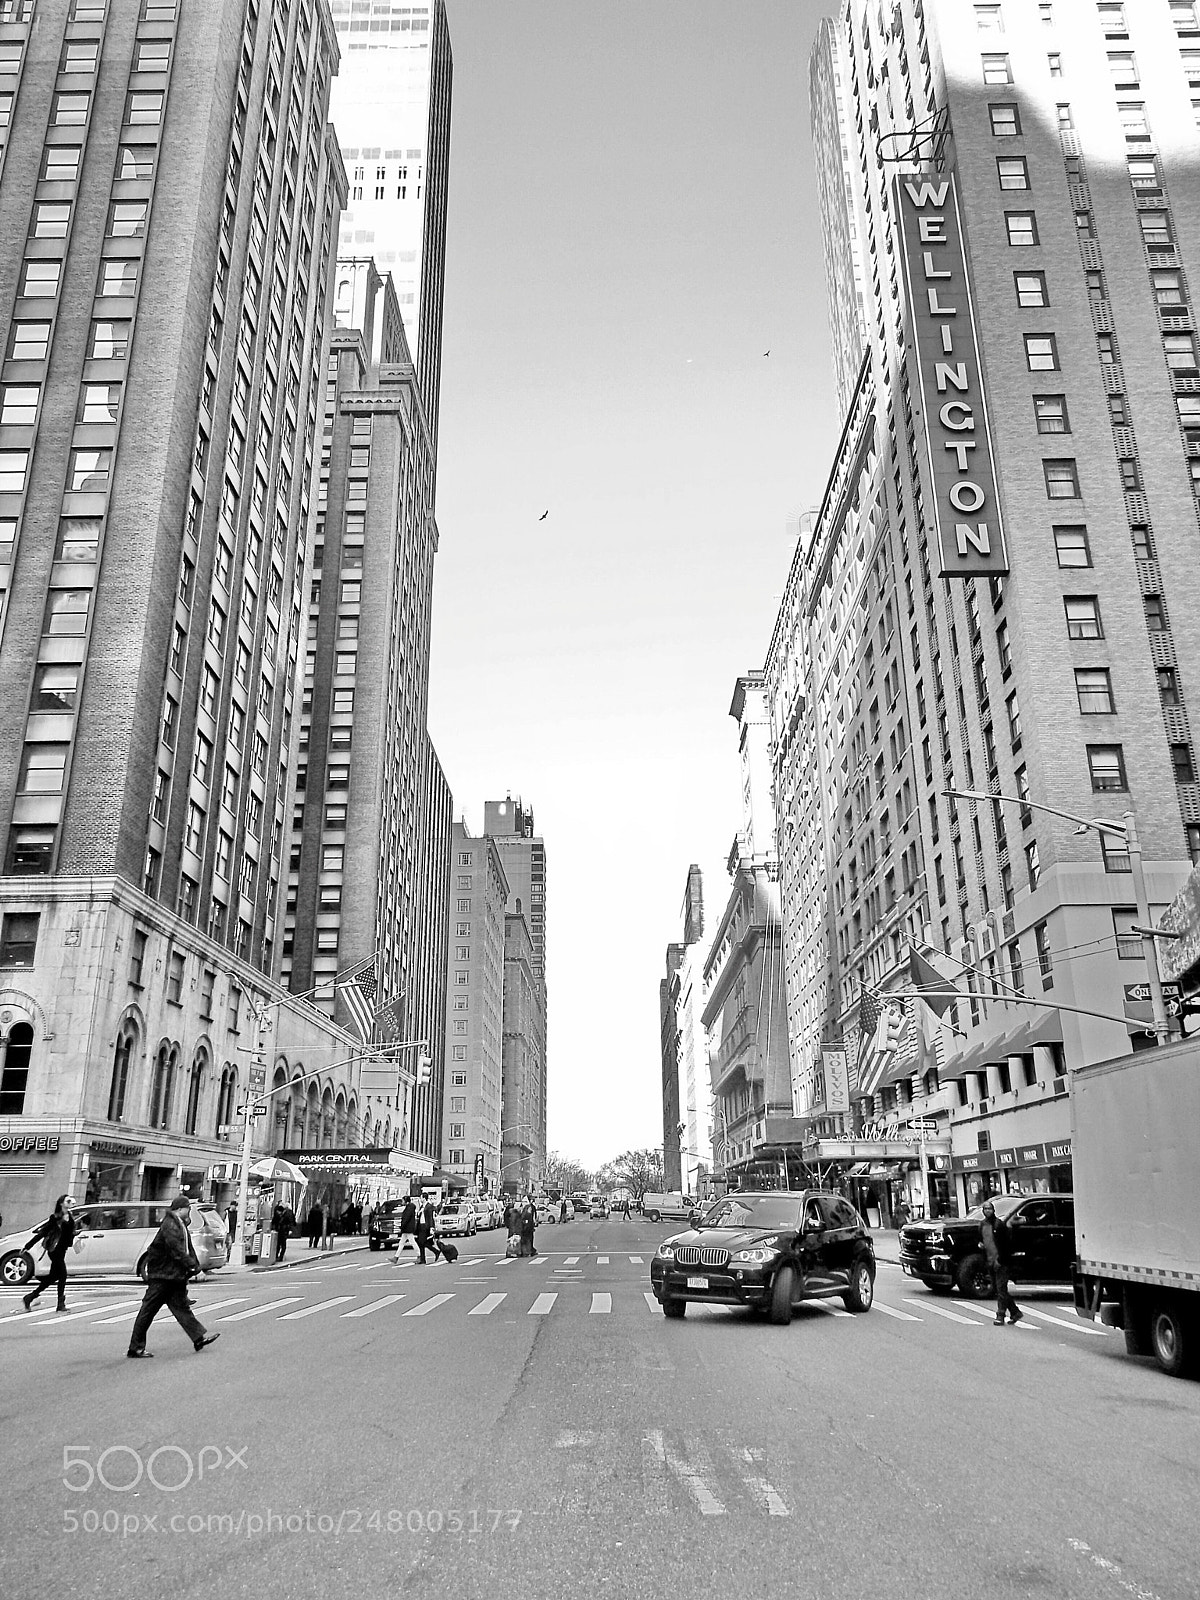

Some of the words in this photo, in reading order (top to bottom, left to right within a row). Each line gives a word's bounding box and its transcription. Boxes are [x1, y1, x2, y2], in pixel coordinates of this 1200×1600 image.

[904, 181, 991, 556] WELLINGTON
[1135, 988, 1152, 996] ONE
[829, 1053, 843, 1105] MOLYVOS
[0, 1136, 60, 1152] OFFEE
[325, 1154, 372, 1162] CENTRAL
